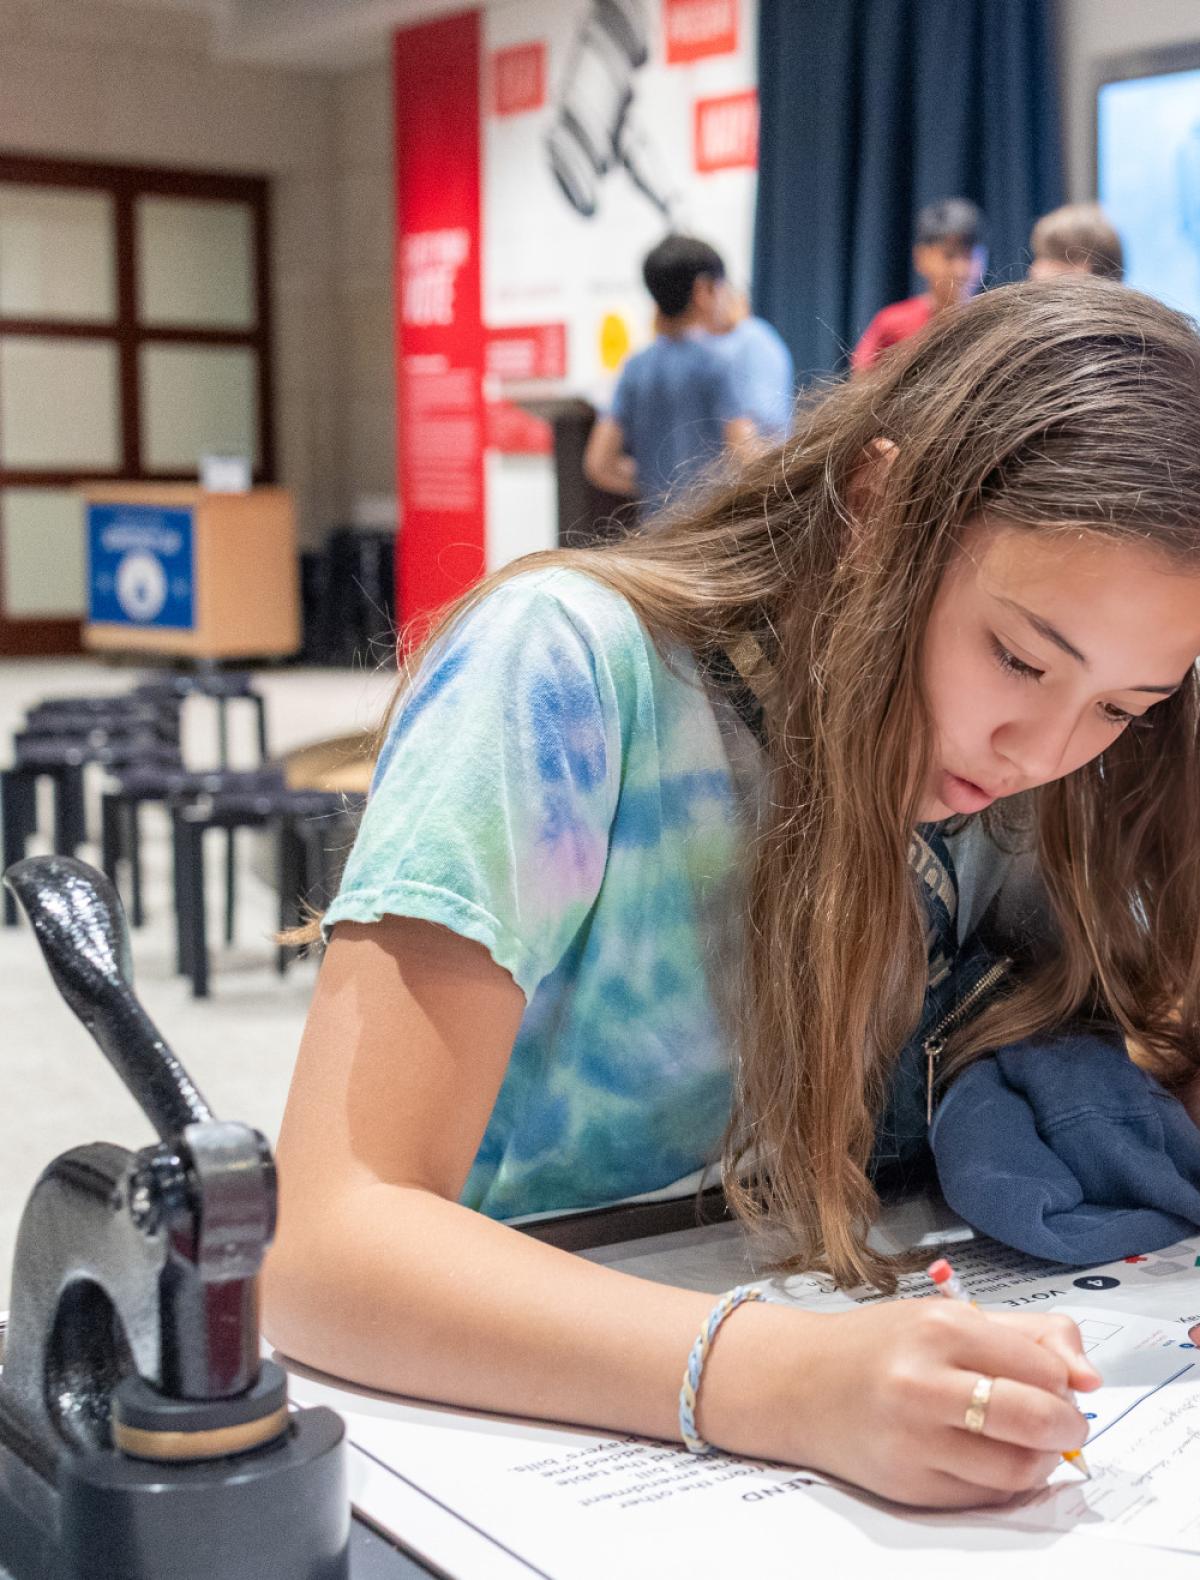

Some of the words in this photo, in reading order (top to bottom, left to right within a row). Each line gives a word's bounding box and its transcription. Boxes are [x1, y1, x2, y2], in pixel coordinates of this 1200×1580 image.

[1086, 1279, 1104, 1287] 4
[1001, 1289, 1067, 1307] VOTE
[583, 1447, 648, 1469] added
[613, 1459, 649, 1471] the
[541, 1463, 580, 1478] one
[556, 1469, 611, 1486] table
[715, 1464, 766, 1482] from
[578, 1469, 700, 1507] amendment
[677, 1480, 714, 1492] the
[620, 1489, 673, 1509] other
